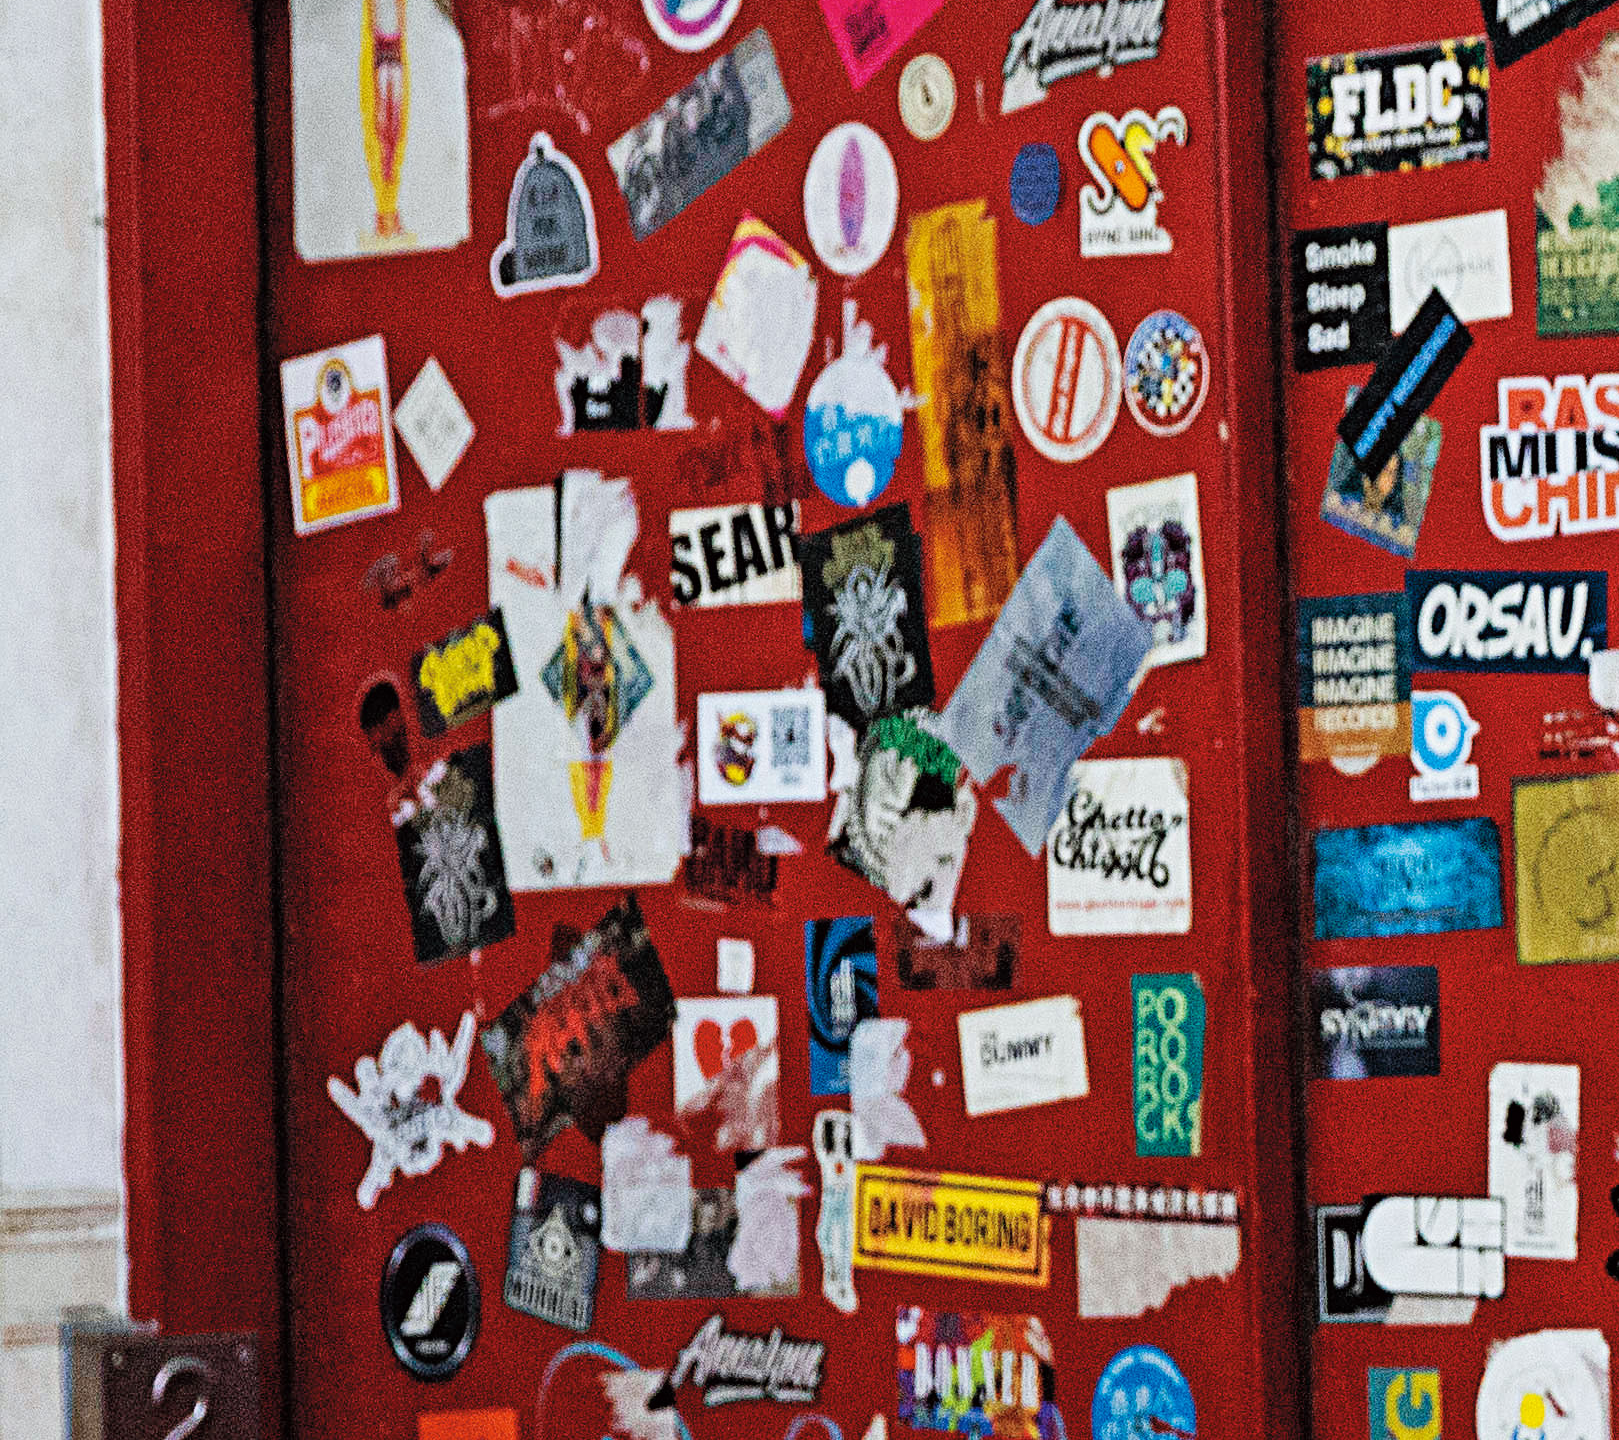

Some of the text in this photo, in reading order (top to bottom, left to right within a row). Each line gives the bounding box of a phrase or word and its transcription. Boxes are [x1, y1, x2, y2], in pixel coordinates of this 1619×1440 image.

[1416, 583, 1594, 661] ORSAU.
[866, 1197, 1032, 1252] DAVID BORING
